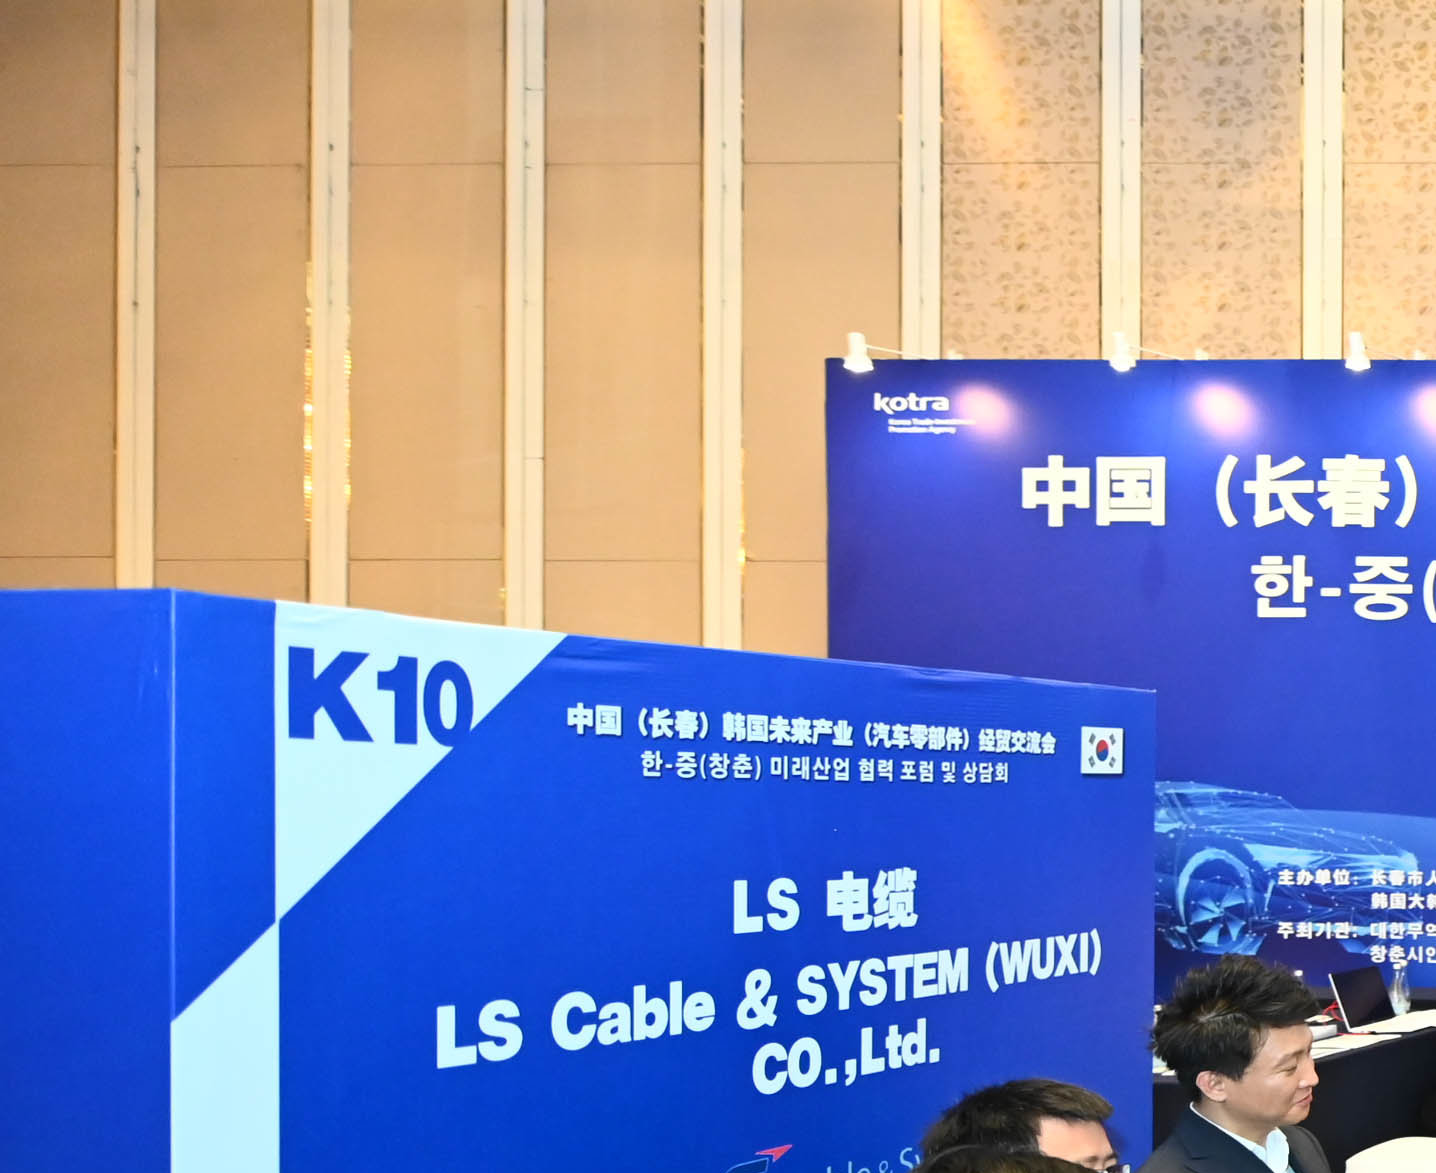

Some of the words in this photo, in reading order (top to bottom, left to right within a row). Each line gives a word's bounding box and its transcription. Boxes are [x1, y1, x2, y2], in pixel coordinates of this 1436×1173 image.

[873, 392, 951, 415] kotra
[287, 645, 475, 748] K10
[640, 749, 762, 782] 한-중(창춘)
[770, 757, 850, 783] 미래산업
[858, 758, 895, 784] 협력
[900, 759, 936, 785] 포럼
[941, 761, 957, 786] 및
[962, 761, 1009, 785] 상담회
[732, 878, 800, 933] LS
[826, 867, 918, 933] 电缆
[1277, 920, 1358, 940] 주최기관:
[436, 1000, 523, 1070] LS
[550, 980, 716, 1052] Cable
[736, 967, 778, 1030] &
[797, 947, 970, 1017] SYSTEM
[985, 928, 1103, 991] (WUXI)
[752, 1018, 941, 1095] CO.,Ltd.
